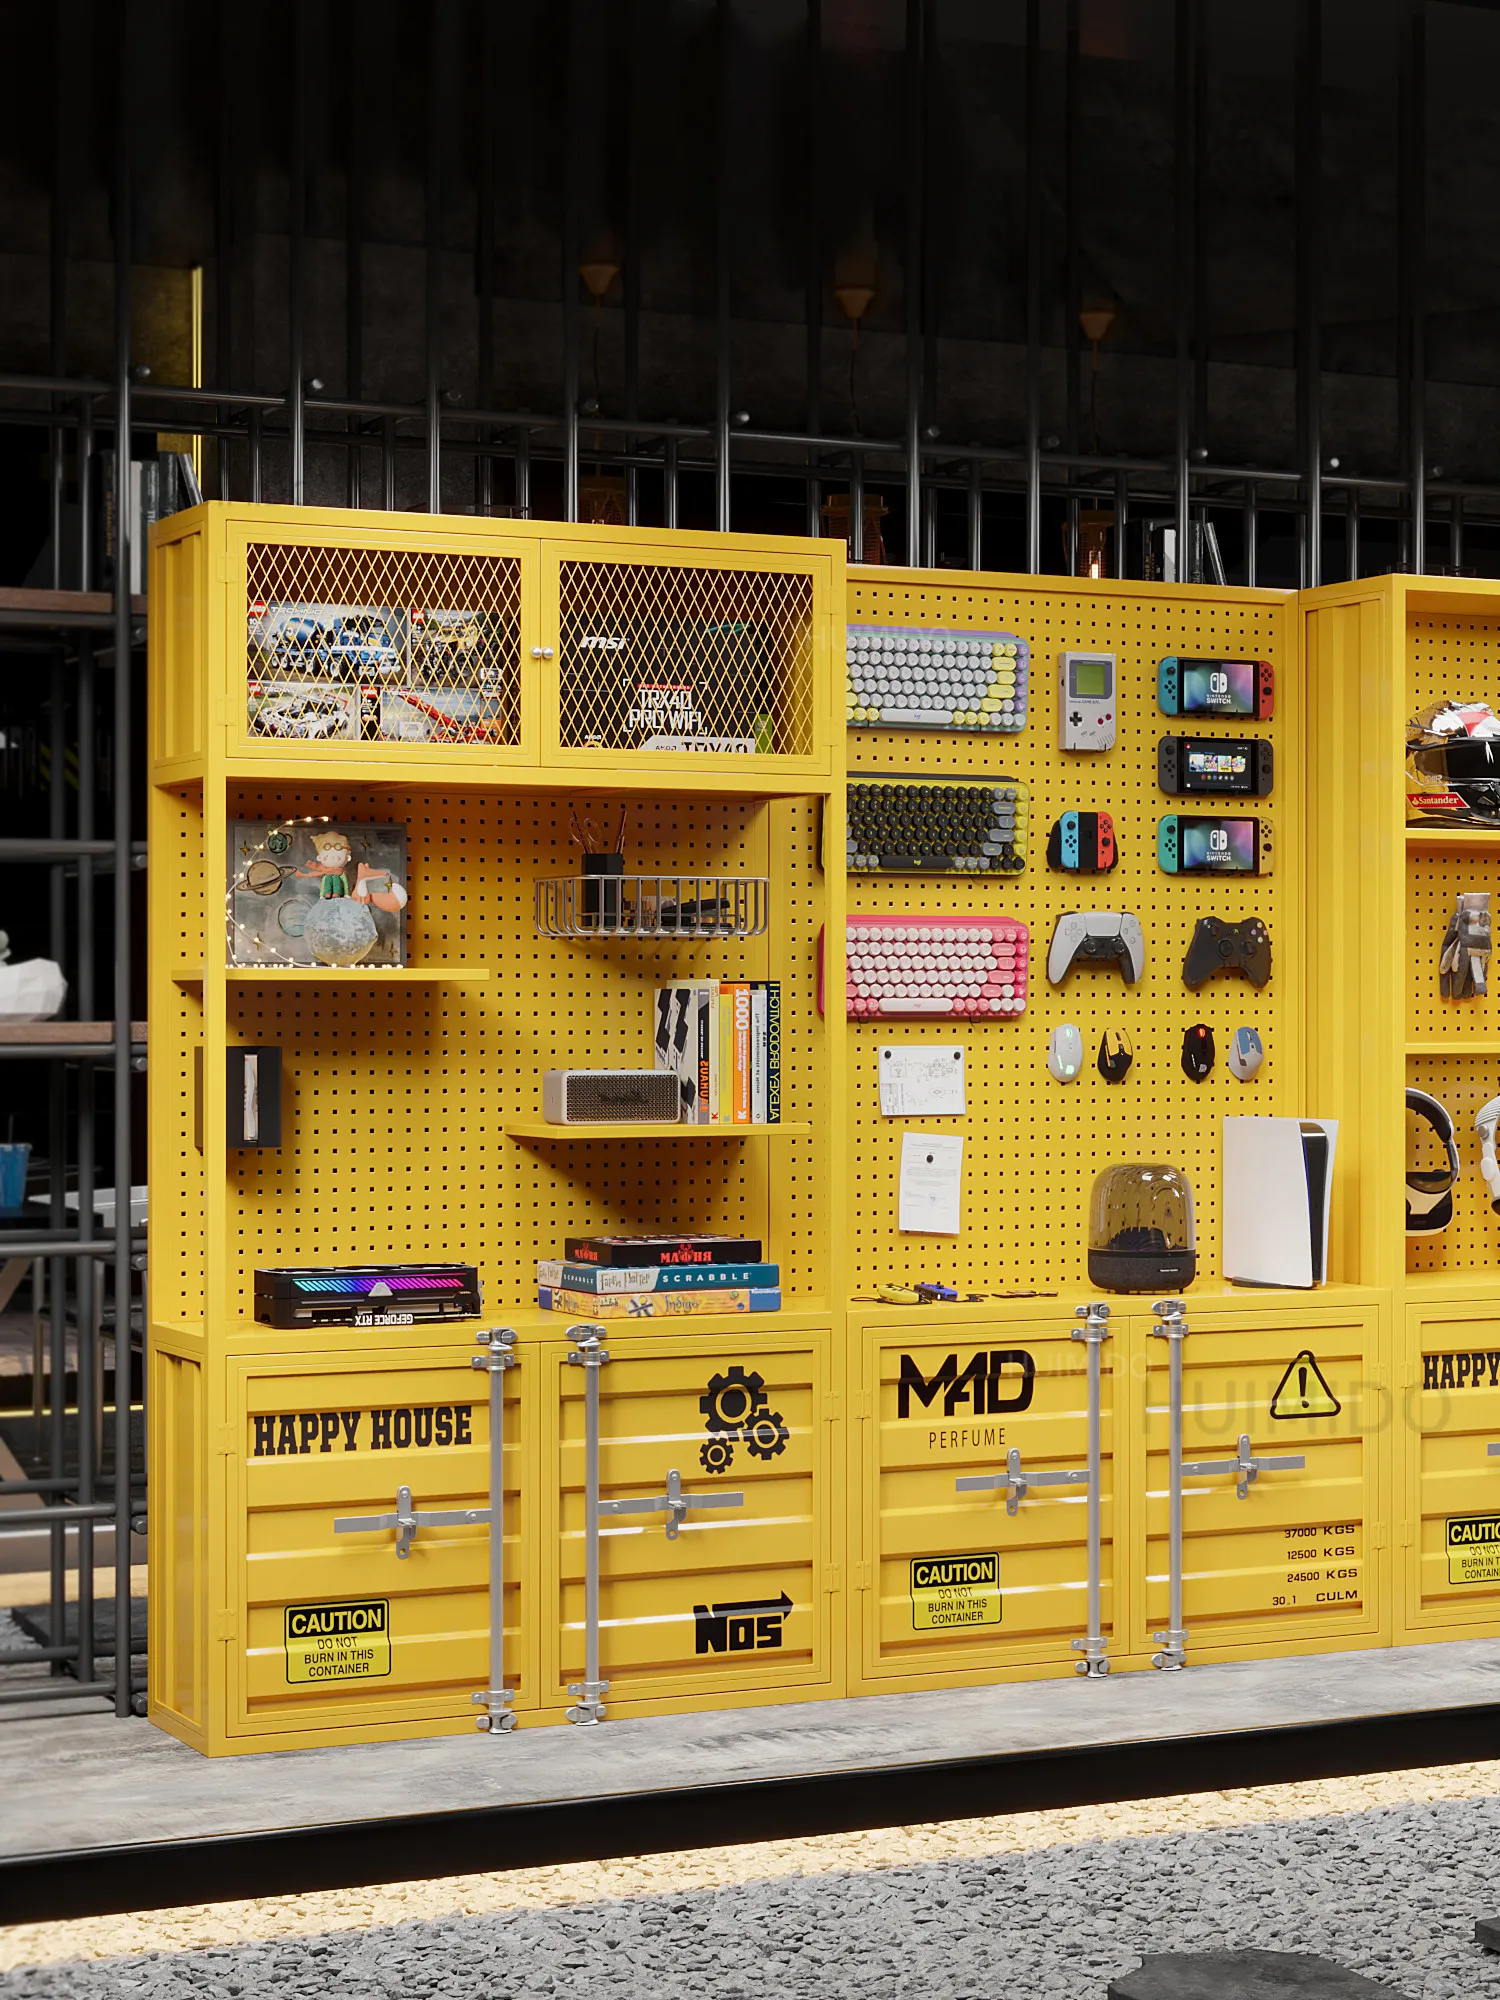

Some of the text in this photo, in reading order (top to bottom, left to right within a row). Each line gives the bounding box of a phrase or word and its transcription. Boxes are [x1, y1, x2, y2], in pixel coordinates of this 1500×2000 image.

[580, 636, 625, 650] msi
[639, 689, 692, 710] TRX40
[629, 708, 664, 729] PRO
[1418, 796, 1459, 805] Santander
[736, 988, 750, 1030] 1000
[564, 1274, 594, 1285] SCRABBLE
[662, 1272, 749, 1283] SCRABBLE
[665, 1295, 699, 1314] Indigo
[354, 1314, 413, 1326] GEFORCE RTX
[1424, 1352, 1499, 1389] HAPPY
[898, 1350, 1036, 1418] MAD
[254, 1405, 472, 1456] HAPPY HOUSE
[930, 1428, 1006, 1449] PERFUME
[1284, 1525, 1355, 1538] 37000 KGS
[1287, 1546, 1355, 1560] 12500 KGS
[1462, 1559, 1484, 1568] BURN
[1486, 1557, 1493, 1566] IN
[917, 1562, 993, 1585] CAUTION
[1287, 1569, 1358, 1582] 24500 KGS
[938, 1587, 972, 1599] DO NOT
[1316, 1590, 1358, 1602] CULM
[928, 1598, 988, 1613] BURN IN THIS
[291, 1608, 382, 1635] CAUTION
[693, 1589, 794, 1655] NOS
[931, 1611, 984, 1624] CONTAINER
[317, 1636, 357, 1650] DO NOT
[304, 1648, 374, 1664] BURN IN THIS
[308, 1662, 369, 1677] CONTAINER
